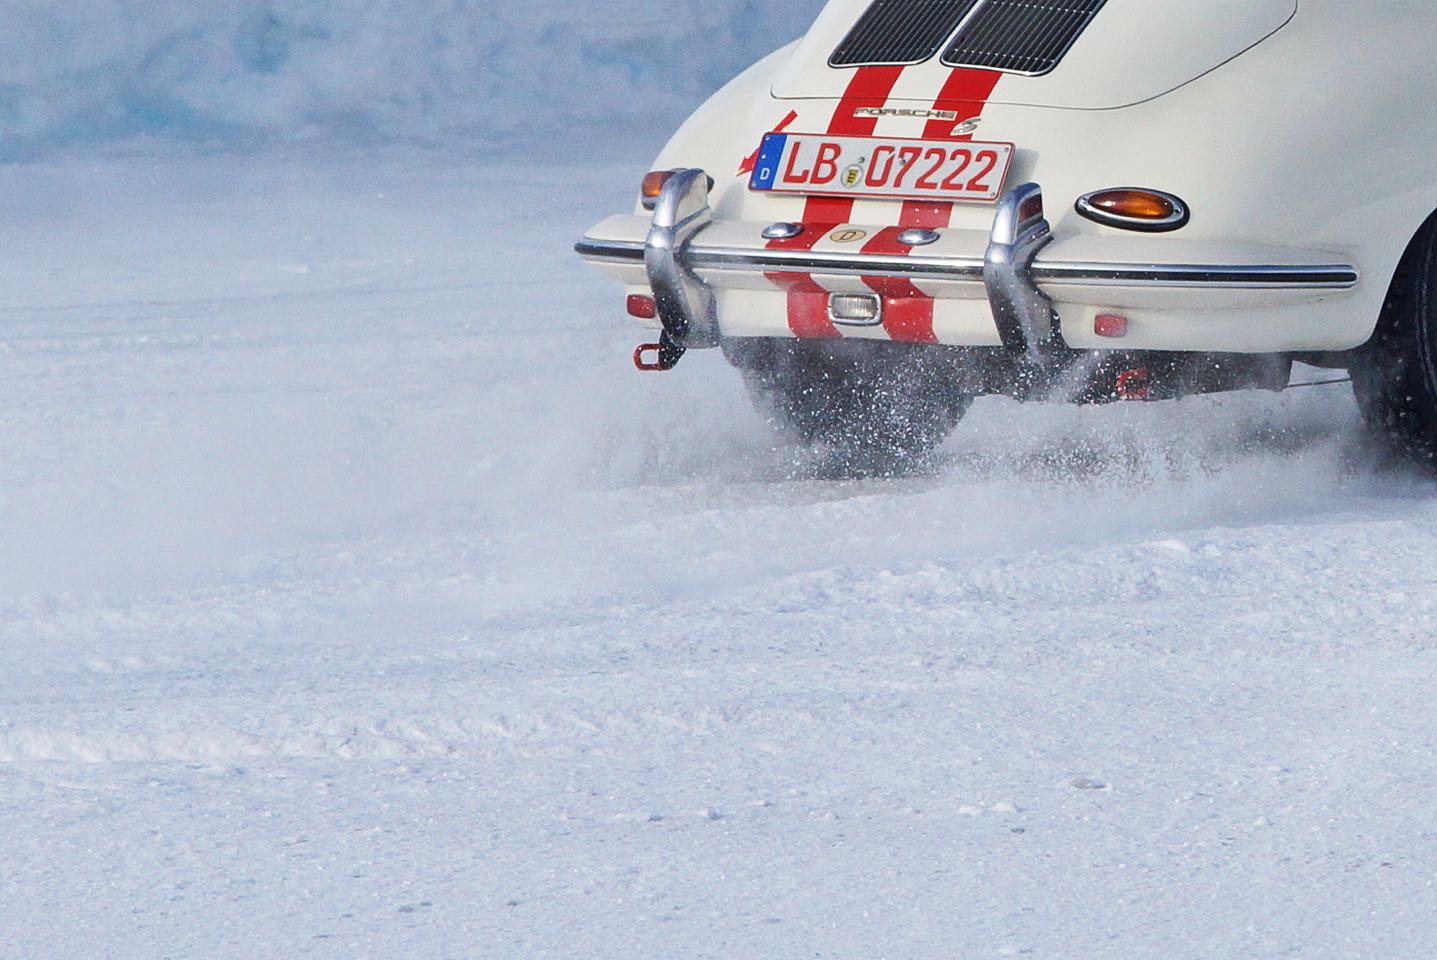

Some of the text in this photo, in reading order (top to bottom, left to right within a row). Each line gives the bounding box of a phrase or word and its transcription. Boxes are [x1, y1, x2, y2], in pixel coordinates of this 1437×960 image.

[855, 108, 956, 120] PORSCHE
[782, 141, 998, 192] LB 07222
[759, 168, 770, 180] D
